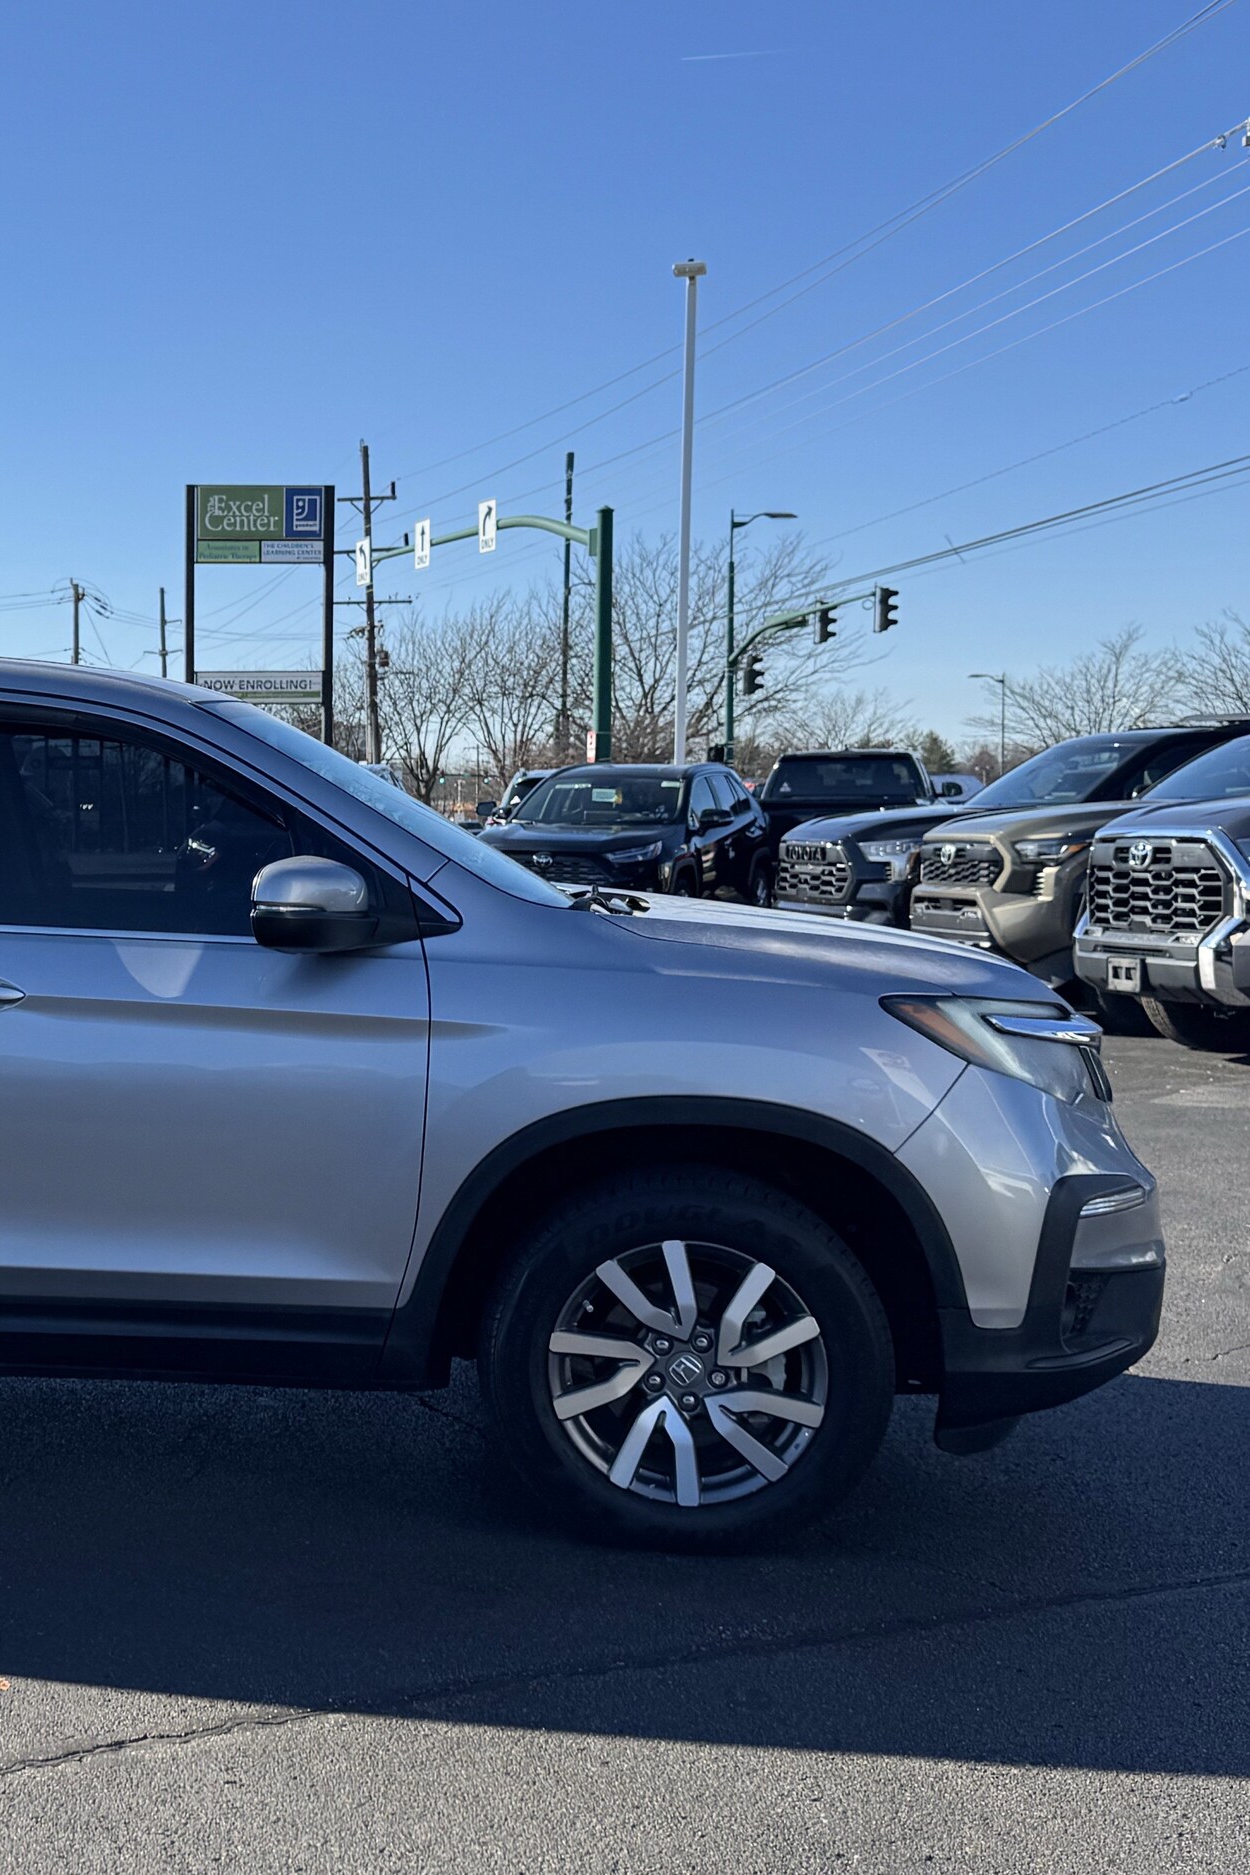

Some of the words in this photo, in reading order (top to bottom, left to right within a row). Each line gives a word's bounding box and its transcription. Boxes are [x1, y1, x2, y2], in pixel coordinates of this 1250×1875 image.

[213, 494, 270, 516] Excel
[205, 510, 279, 531] Center
[481, 538, 494, 550] ONLY
[203, 680, 235, 690] NOW
[238, 680, 312, 690] ENROLLING!
[788, 846, 822, 860] TOYOTA
